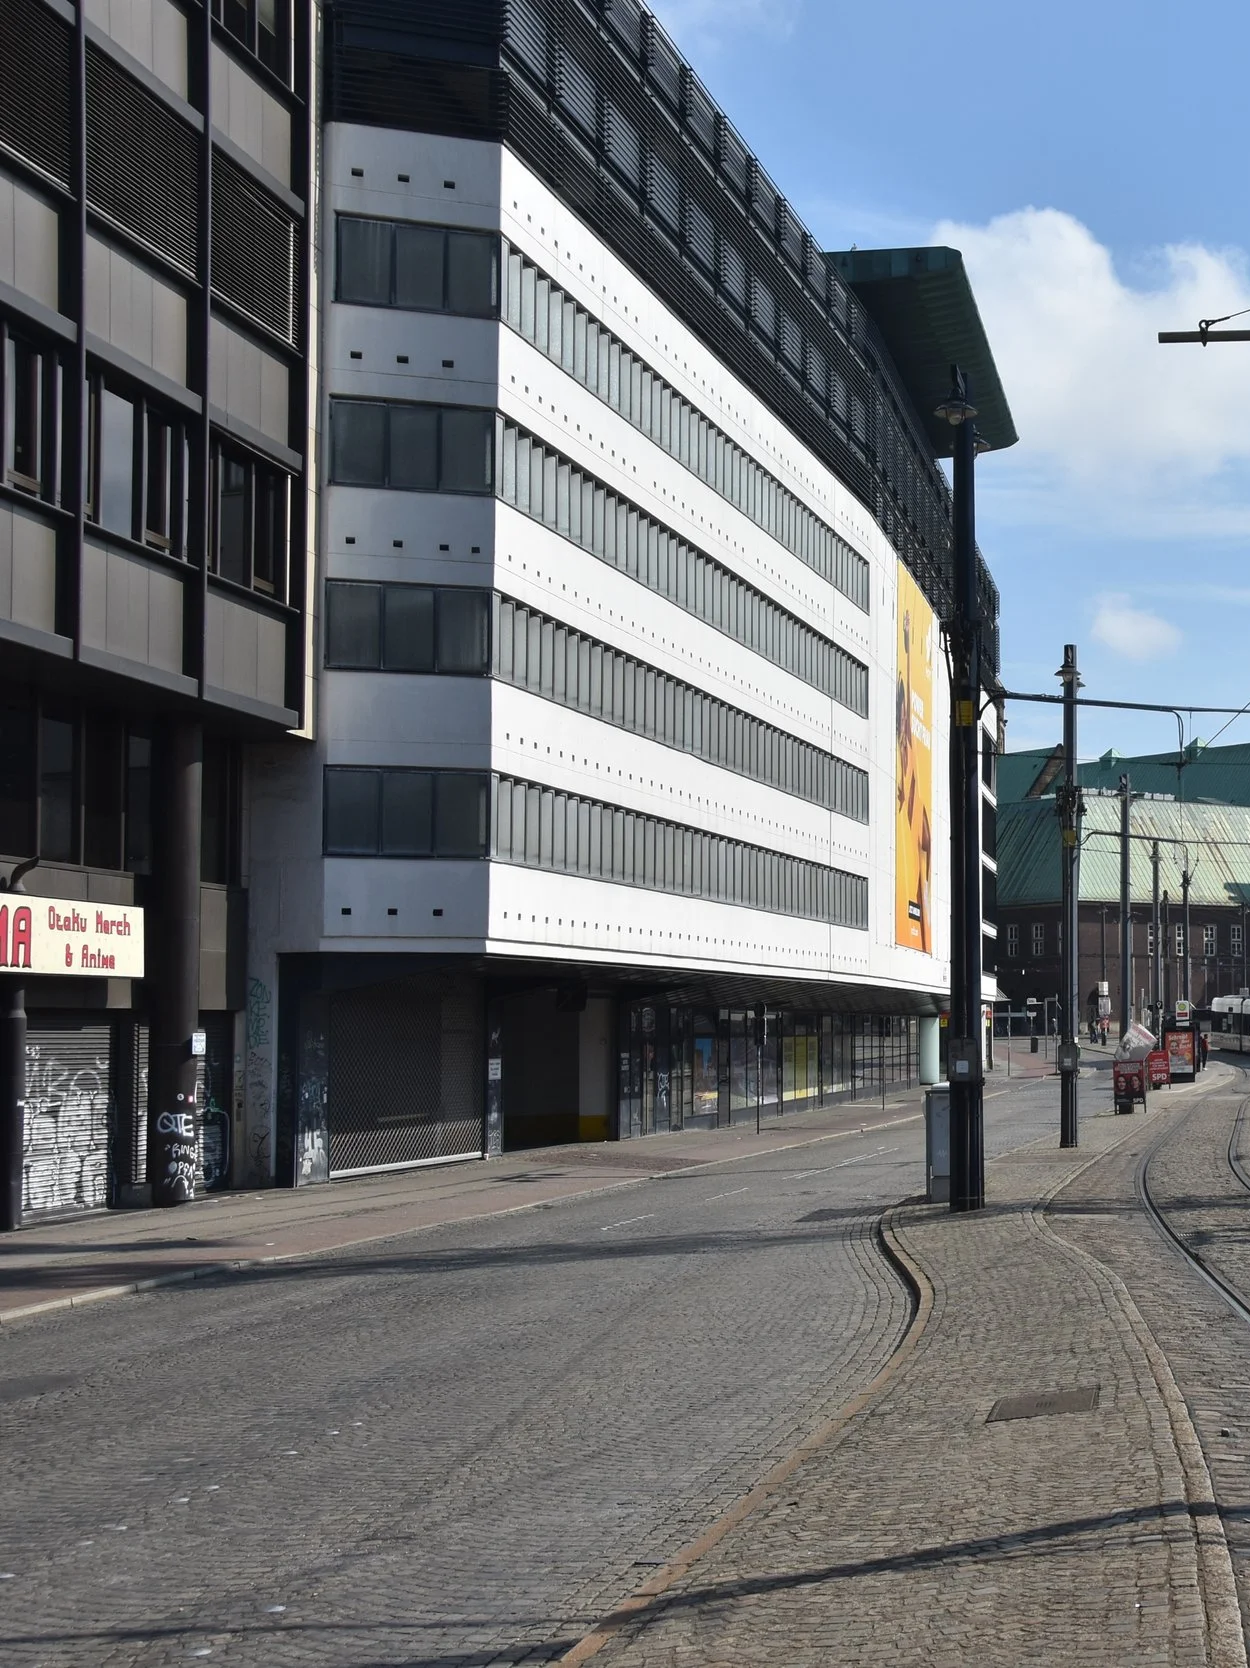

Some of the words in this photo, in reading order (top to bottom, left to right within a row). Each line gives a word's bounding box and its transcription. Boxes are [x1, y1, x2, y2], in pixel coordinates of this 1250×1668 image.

[48, 905, 87, 932] Otaku
[95, 909, 131, 936] Merch
[81, 944, 115, 969] Anime
[1152, 1073, 1167, 1081] SPD
